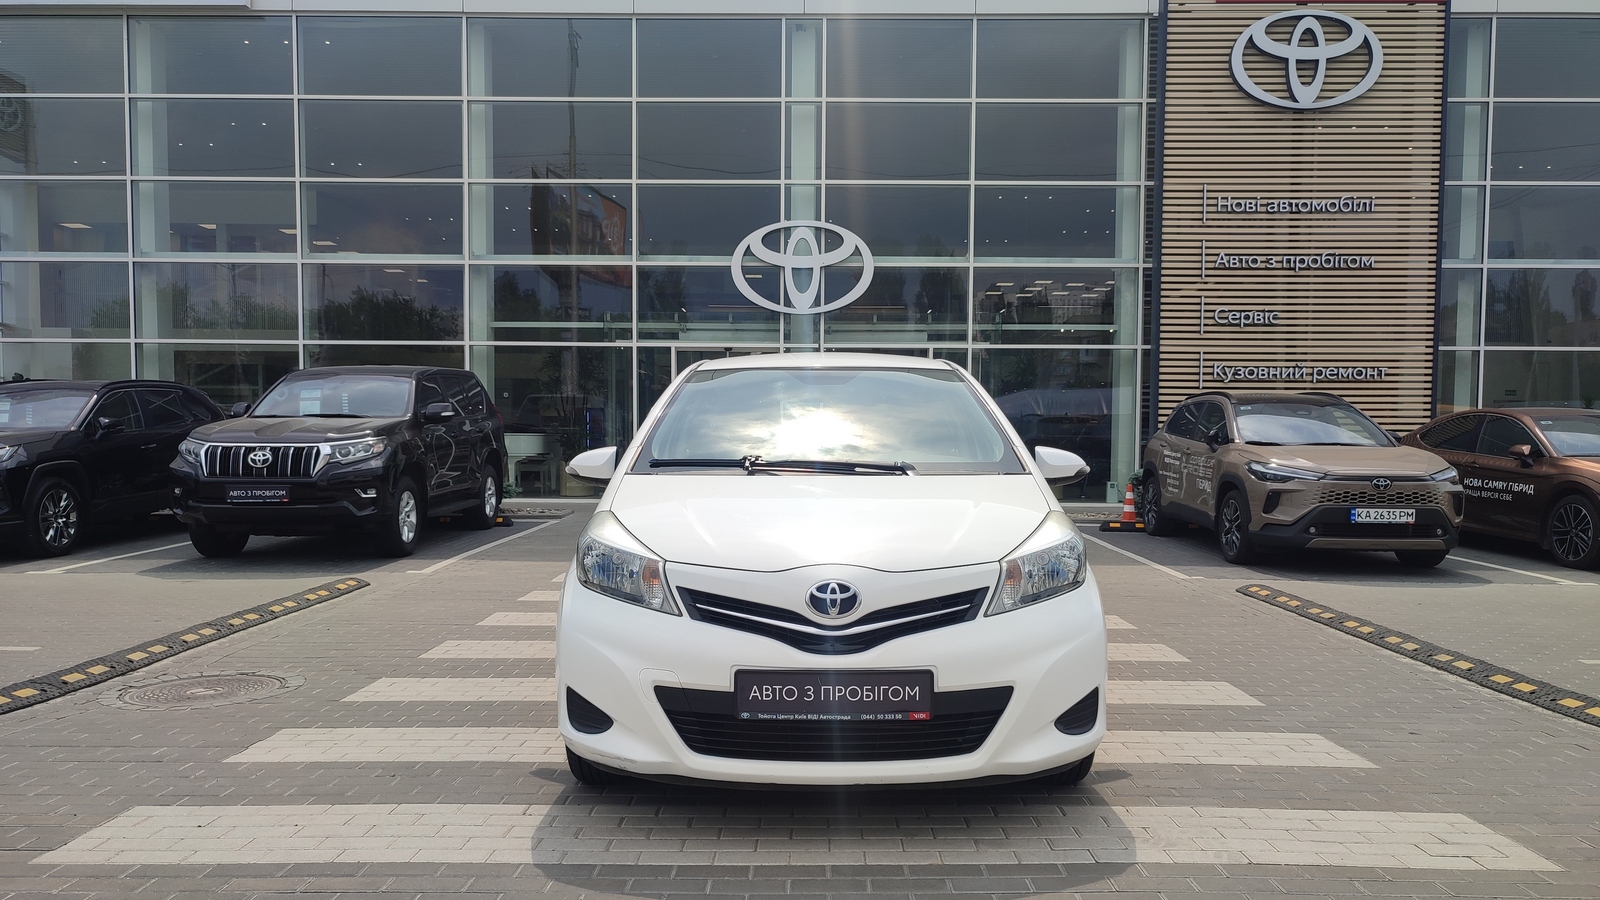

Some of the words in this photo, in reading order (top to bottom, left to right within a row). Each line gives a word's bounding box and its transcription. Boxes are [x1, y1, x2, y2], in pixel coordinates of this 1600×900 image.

[1216, 195, 1261, 212] Нові
[1266, 195, 1376, 213] автомобілі
[1214, 251, 1261, 268] Авто
[1265, 256, 1276, 268] з
[1282, 251, 1376, 272] пробігом
[1214, 307, 1281, 328] Сервіс
[1213, 362, 1306, 383] Кузовний
[1312, 366, 1388, 383] ремонт
[1463, 477, 1482, 488] НОВА
[1483, 479, 1508, 490] CAMRY
[1508, 482, 1535, 495] ГІБРИД
[1481, 491, 1499, 499] ВЕРСІЯ
[1499, 493, 1513, 501] СЕБЕ
[1356, 510, 1372, 520] KA
[1373, 510, 1397, 520] 2635
[1399, 510, 1414, 520] PM
[749, 685, 798, 701] АВТО
[803, 685, 815, 701] З
[821, 685, 920, 701] ПРОБІГОМ
